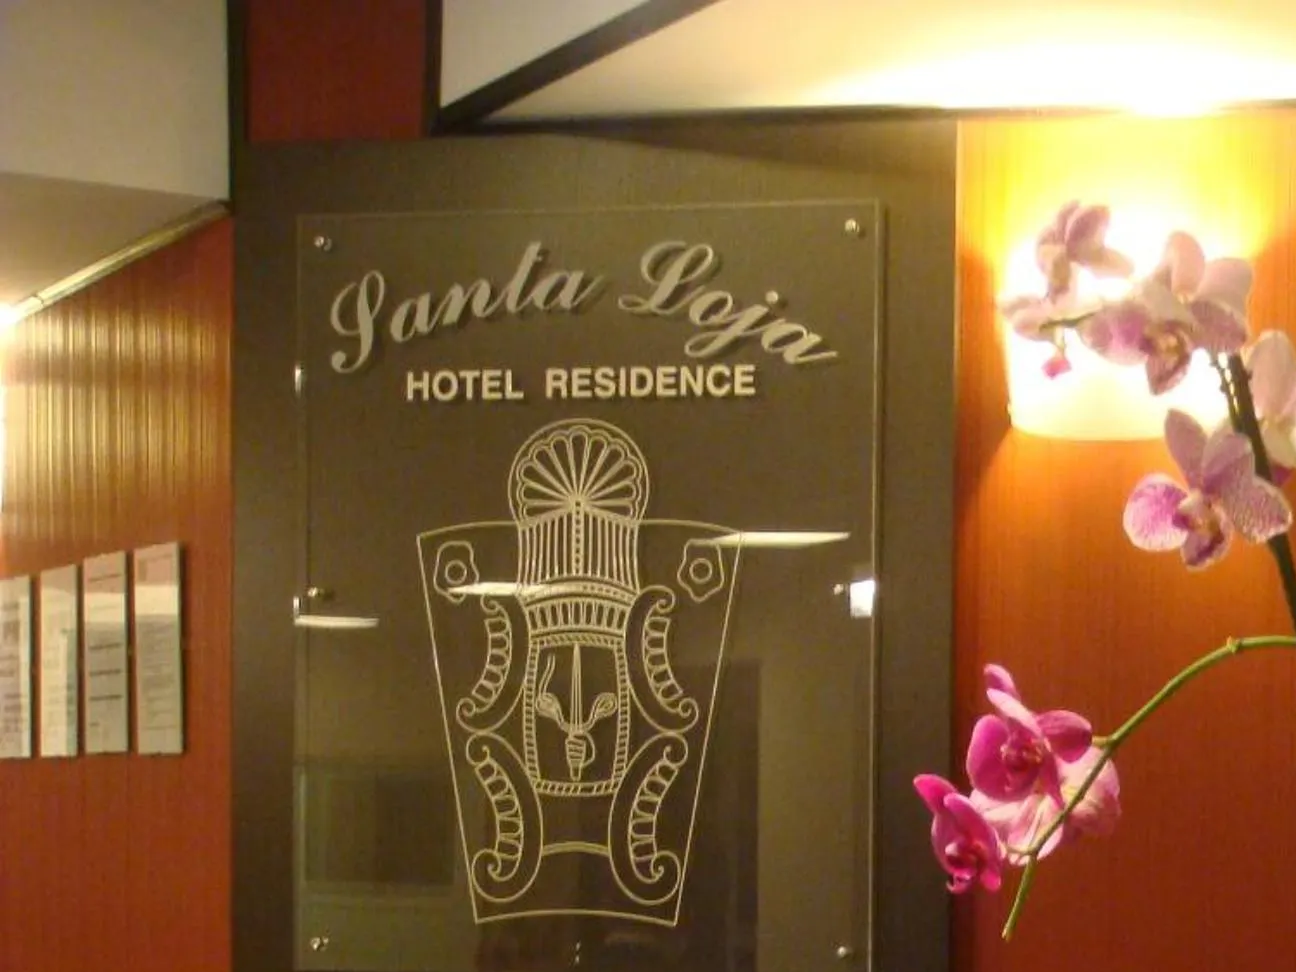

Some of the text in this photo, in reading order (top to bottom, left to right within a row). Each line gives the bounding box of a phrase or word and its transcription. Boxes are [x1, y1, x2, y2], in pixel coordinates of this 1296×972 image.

[330, 241, 839, 374] Santa Loja
[405, 364, 757, 401] HOTEL RESIDENCE
